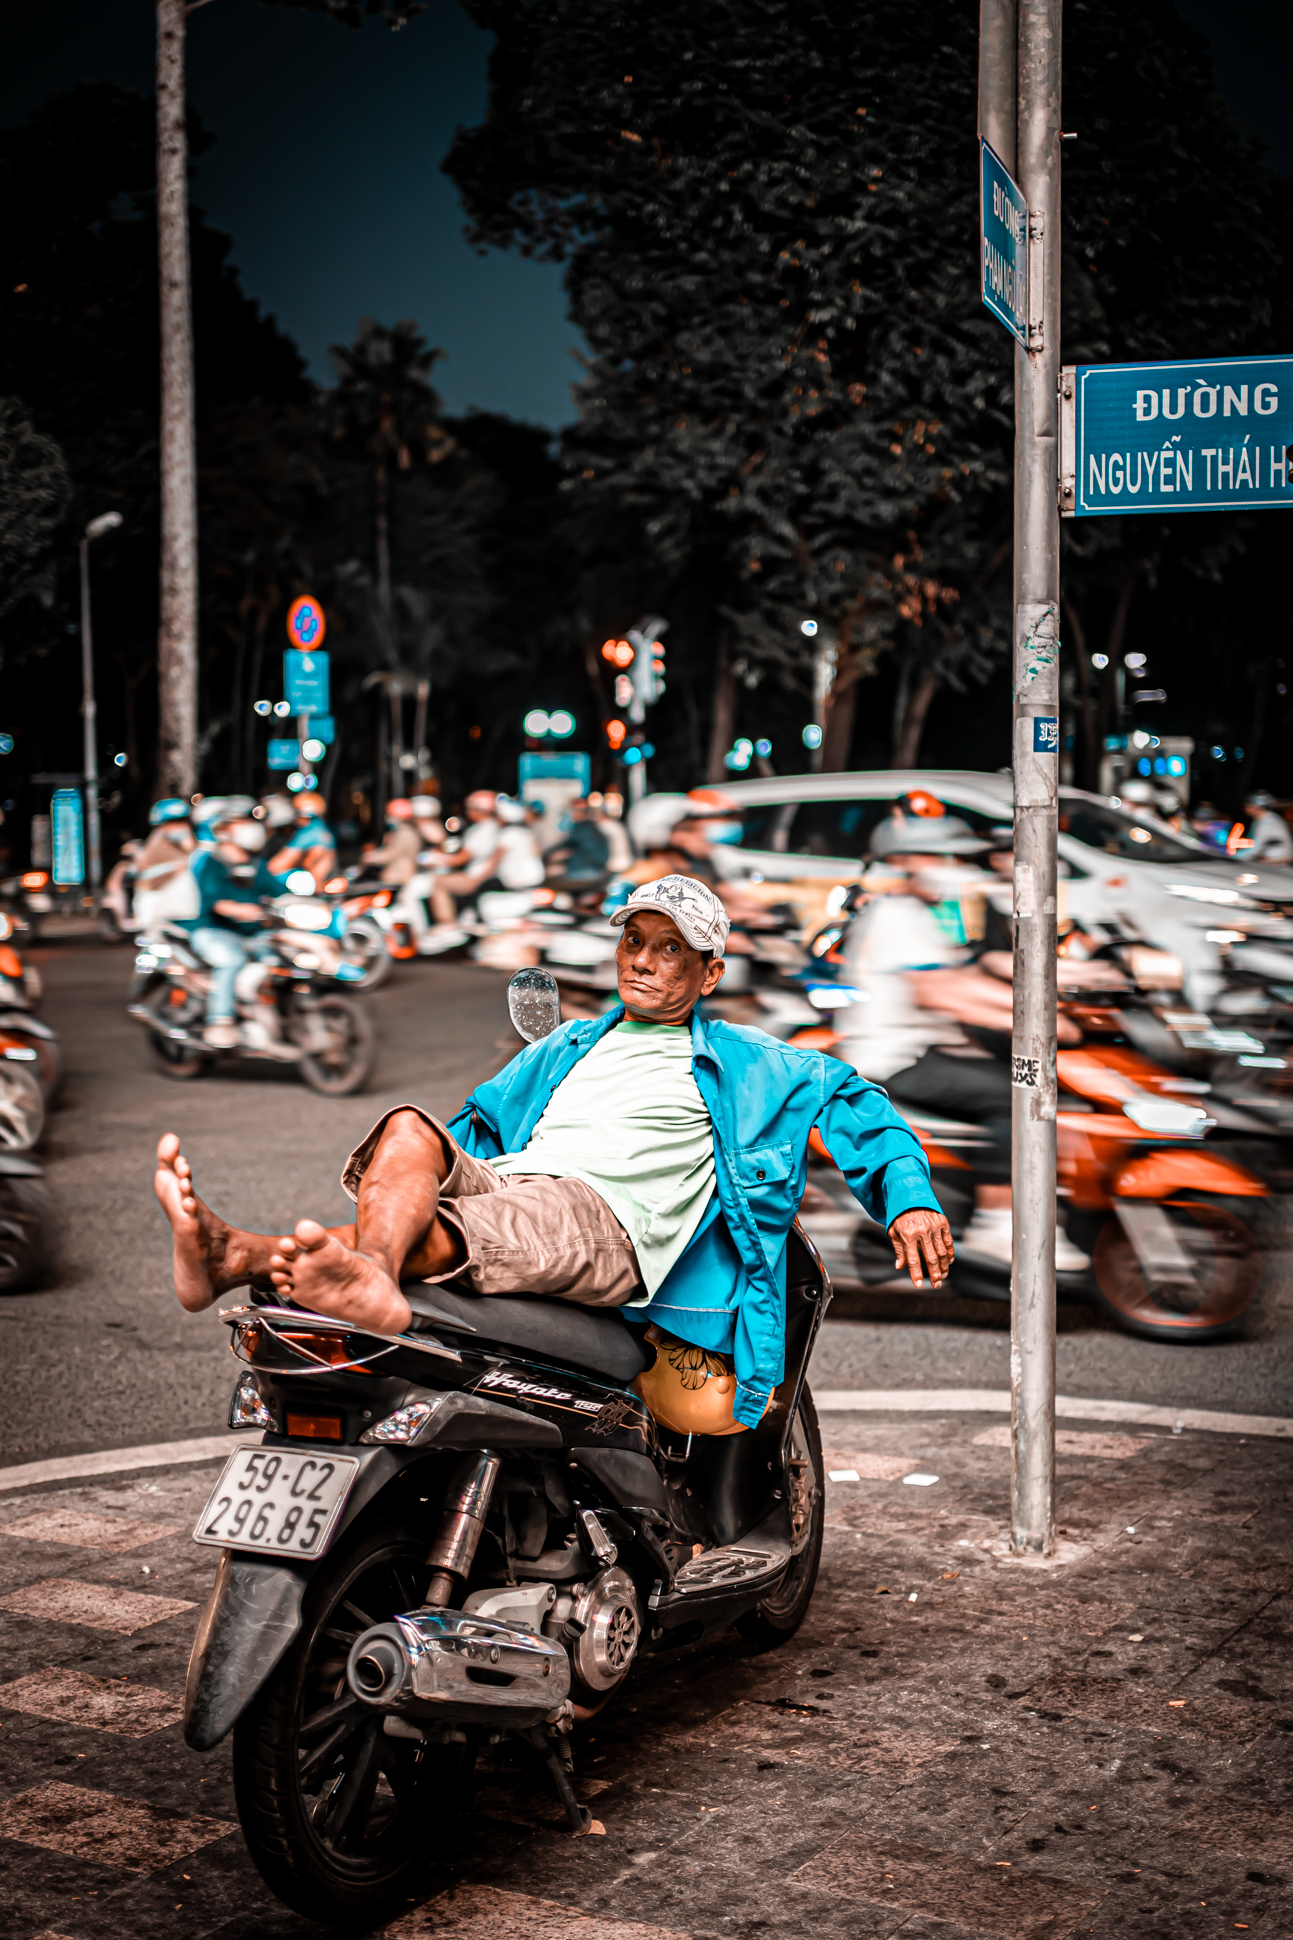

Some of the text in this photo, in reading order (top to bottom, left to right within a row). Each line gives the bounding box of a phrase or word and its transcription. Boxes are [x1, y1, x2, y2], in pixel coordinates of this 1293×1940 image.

[1132, 378, 1279, 422] ĐƯỜNG
[1089, 434, 1293, 495] NGUYỄN THÁI H
[573, 1400, 605, 1413] 125
[238, 1453, 336, 1501] 59-C2
[204, 1496, 329, 1550] 296.85
